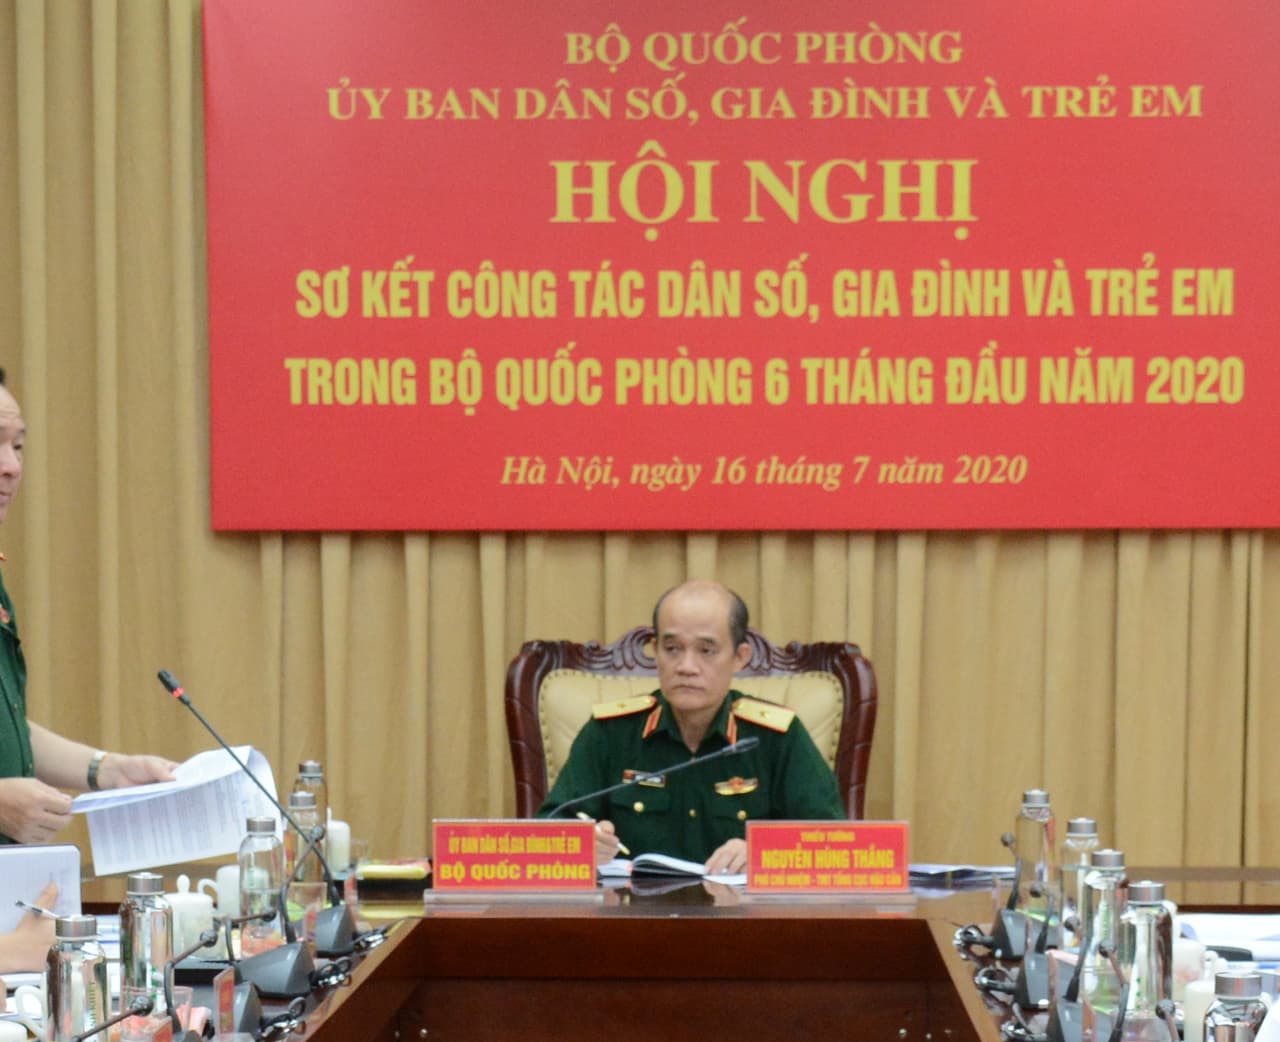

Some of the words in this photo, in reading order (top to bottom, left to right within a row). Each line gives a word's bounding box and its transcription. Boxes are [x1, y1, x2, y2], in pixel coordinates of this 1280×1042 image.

[566, 23, 632, 72] BỘ
[643, 17, 782, 71] QUỐC
[795, 22, 963, 65] PHÒNG
[327, 79, 390, 120] ỦY
[405, 87, 500, 120] BAN
[515, 79, 612, 120] DÂN
[626, 72, 700, 124] SỐ,
[710, 86, 796, 119] GIA
[810, 79, 930, 120] ĐÌNH
[943, 77, 1008, 119] VÀ
[1021, 75, 1117, 119] TRẺ
[1130, 84, 1203, 118] EM
[550, 139, 717, 242] HỘI
[743, 159, 977, 241] NGHỊ
[295, 266, 350, 318] SƠ
[362, 256, 435, 318] KẾT
[447, 261, 557, 319] CÔNG
[568, 261, 645, 319] TÁC
[657, 261, 742, 318] DÂN
[754, 254, 820, 322] SỐ,
[833, 269, 901, 318] GIA
[911, 260, 1010, 317] ĐÌNH
[1022, 259, 1074, 317] VÀ
[1084, 253, 1159, 317] TRẺ
[1172, 267, 1235, 317] EM
[284, 357, 417, 406] TRONG
[429, 349, 483, 417] BỘ
[495, 342, 603, 411] QUỐC
[615, 347, 753, 406] PHÒNG
[764, 357, 790, 406] 6
[800, 348, 934, 405] THÁNG
[945, 341, 1028, 405] ĐẦU
[1039, 347, 1135, 405] NĂM
[1146, 356, 1245, 404] 2020
[499, 455, 547, 486] Hà
[556, 455, 621, 491] Nội,
[629, 456, 703, 492] ngày
[711, 455, 749, 486] 16
[754, 455, 845, 492] tháng
[853, 455, 871, 484] 7
[878, 457, 945, 485] năm
[953, 454, 1029, 485] 2020
[440, 861, 466, 883] BỘ
[471, 859, 521, 881] QUỐC
[526, 860, 591, 881] PHÒNG
[761, 842, 813, 869] NGUYỄN
